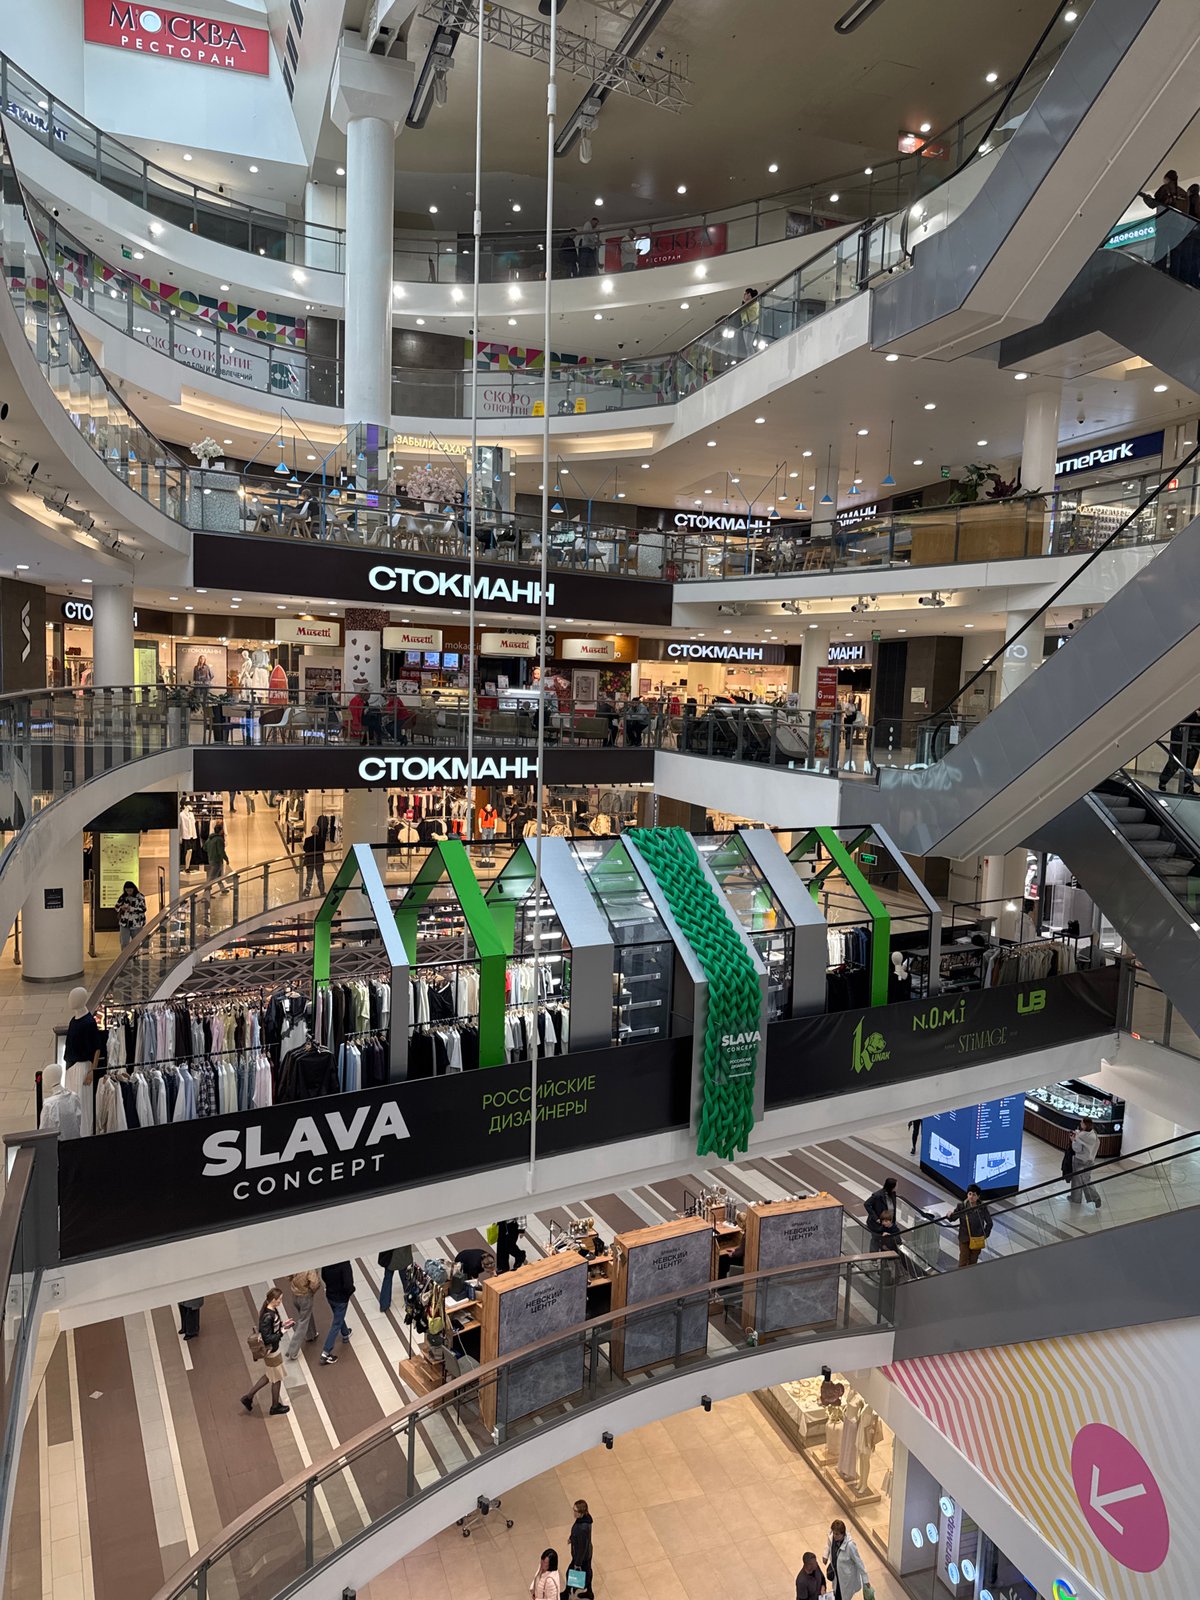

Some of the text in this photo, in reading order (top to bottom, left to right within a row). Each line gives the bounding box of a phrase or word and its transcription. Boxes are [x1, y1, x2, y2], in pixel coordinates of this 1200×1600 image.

[109, 2, 247, 53] МОСКВА
[121, 35, 235, 67] РЕСТОРАН
[397, 434, 467, 455] ЗАБЫЛИ САХАР
[368, 565, 555, 606] СТОКМАНН
[296, 627, 332, 638] Musetti
[401, 634, 434, 645] Musetti
[500, 640, 530, 650] Musetti
[580, 645, 609, 655] Musetti
[667, 643, 763, 660] СТОКМАНН
[817, 690, 823, 699] 6
[358, 757, 539, 782] СТОКМАНН
[721, 1030, 762, 1047] SLAVA
[726, 1043, 757, 1053] CONCEPT
[482, 1075, 596, 1110] РОССИЙСКИЕ
[488, 1099, 588, 1135] ДИЗАЙНЕРЫ
[202, 1100, 411, 1177] SLAVA
[233, 1153, 385, 1200] CONCEPT
[783, 1224, 819, 1236] НЕВСКИЙ
[788, 1232, 813, 1241] ЦЕНТР
[652, 1249, 688, 1266] НЕВСКИЙ
[657, 1259, 683, 1270] ЦЕНТР
[525, 1288, 563, 1309] НЕВСКИЙ
[531, 1299, 557, 1314] ЦЕНТР
